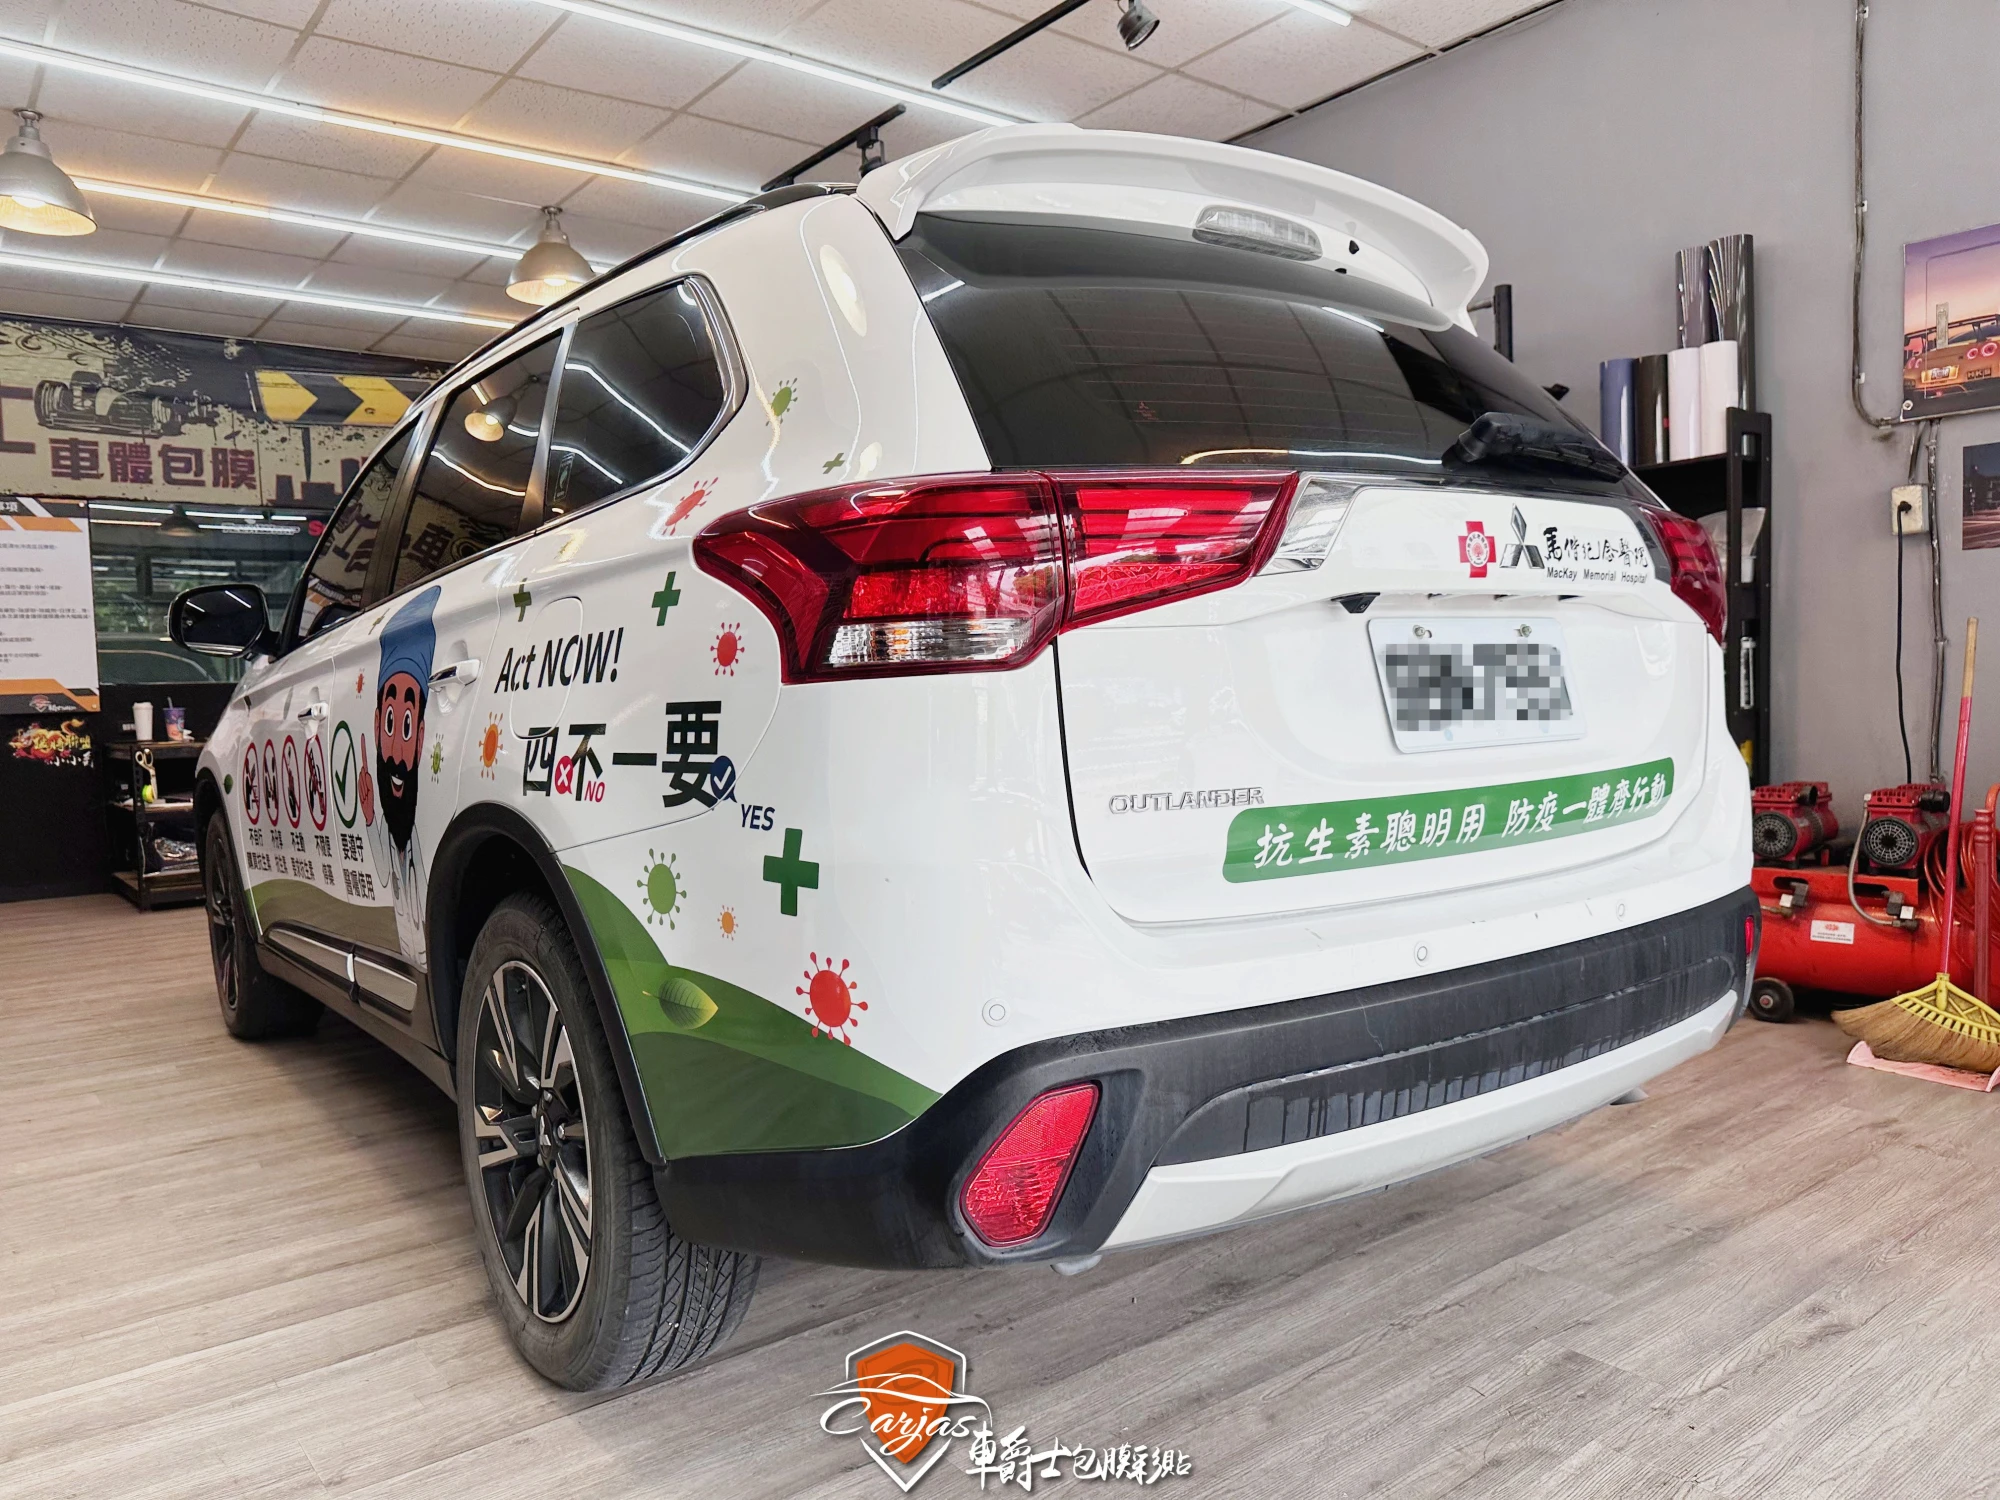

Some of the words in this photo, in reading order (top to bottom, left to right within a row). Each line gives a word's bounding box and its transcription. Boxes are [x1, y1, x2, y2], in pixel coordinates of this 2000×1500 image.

[48, 438, 257, 491] 車體包膜
[1543, 526, 1649, 568] 馬偕紀念醫院
[1546, 566, 1578, 582] MacKay
[1583, 569, 1617, 582] Memorial
[1621, 571, 1648, 585] Hospital
[494, 645, 536, 693] Act
[537, 627, 624, 688] NOW!
[523, 700, 722, 811] 四不一要
[584, 780, 605, 803] NO
[1108, 786, 1265, 815] OUTLANDER
[741, 803, 775, 831] YES
[1253, 803, 1486, 869] 抗生素聰明用
[1501, 772, 1666, 838] 防疫一體齊行動
[340, 833, 364, 863] 要遵守
